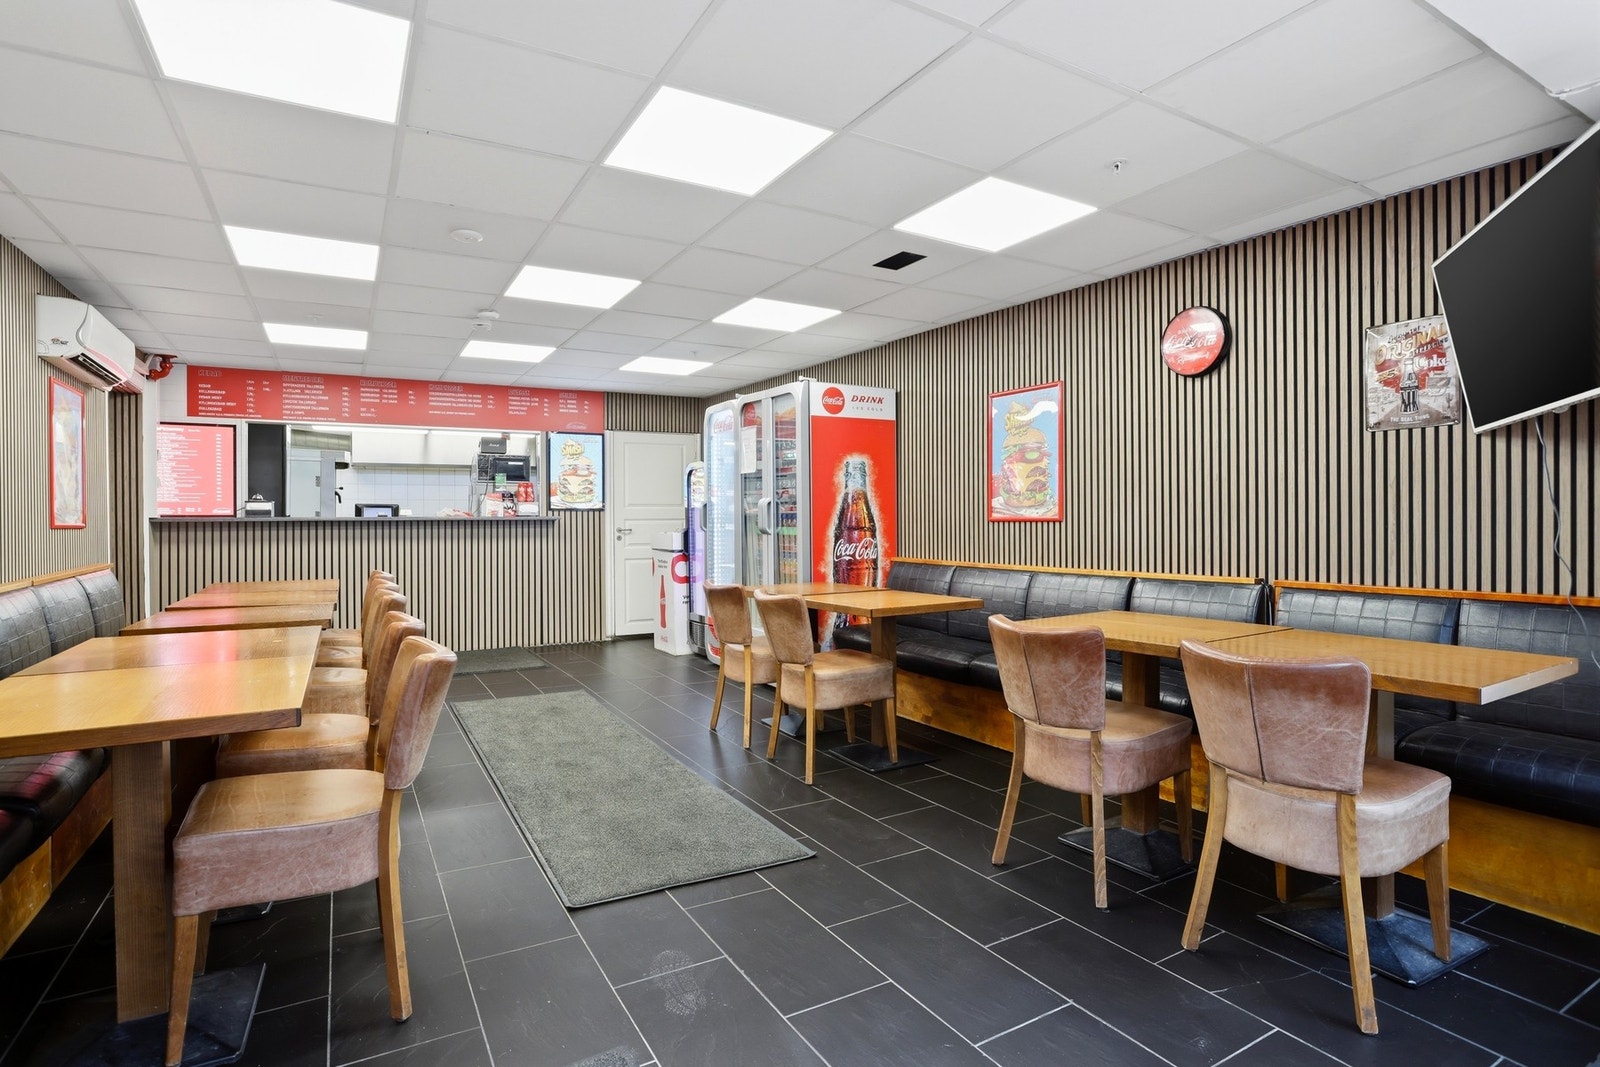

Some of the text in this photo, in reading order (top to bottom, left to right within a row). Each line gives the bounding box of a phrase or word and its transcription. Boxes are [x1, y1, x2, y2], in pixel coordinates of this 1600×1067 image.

[1375, 322, 1448, 366] ORIGINAL
[1414, 354, 1449, 370] Coke
[851, 395, 885, 405] DRINK
[834, 537, 878, 562] Coca-Cola
